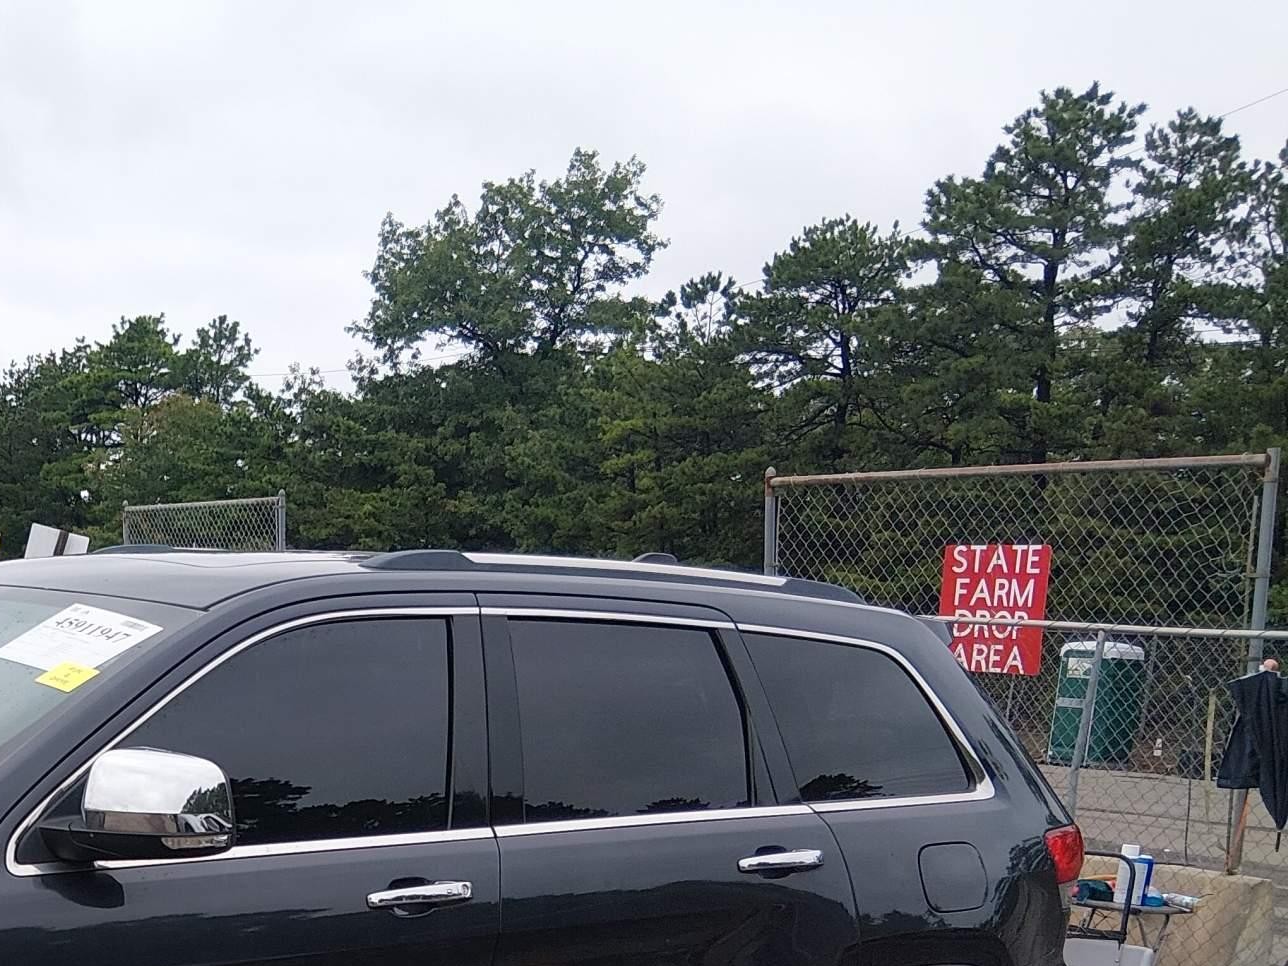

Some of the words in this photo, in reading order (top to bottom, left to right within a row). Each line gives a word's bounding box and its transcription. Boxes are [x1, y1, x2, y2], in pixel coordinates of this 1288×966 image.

[951, 544, 1042, 574] STATE
[953, 577, 1035, 608] FARM
[55, 616, 132, 644] 45911947
[952, 609, 1029, 640] DROP
[953, 642, 1025, 675] AREA
